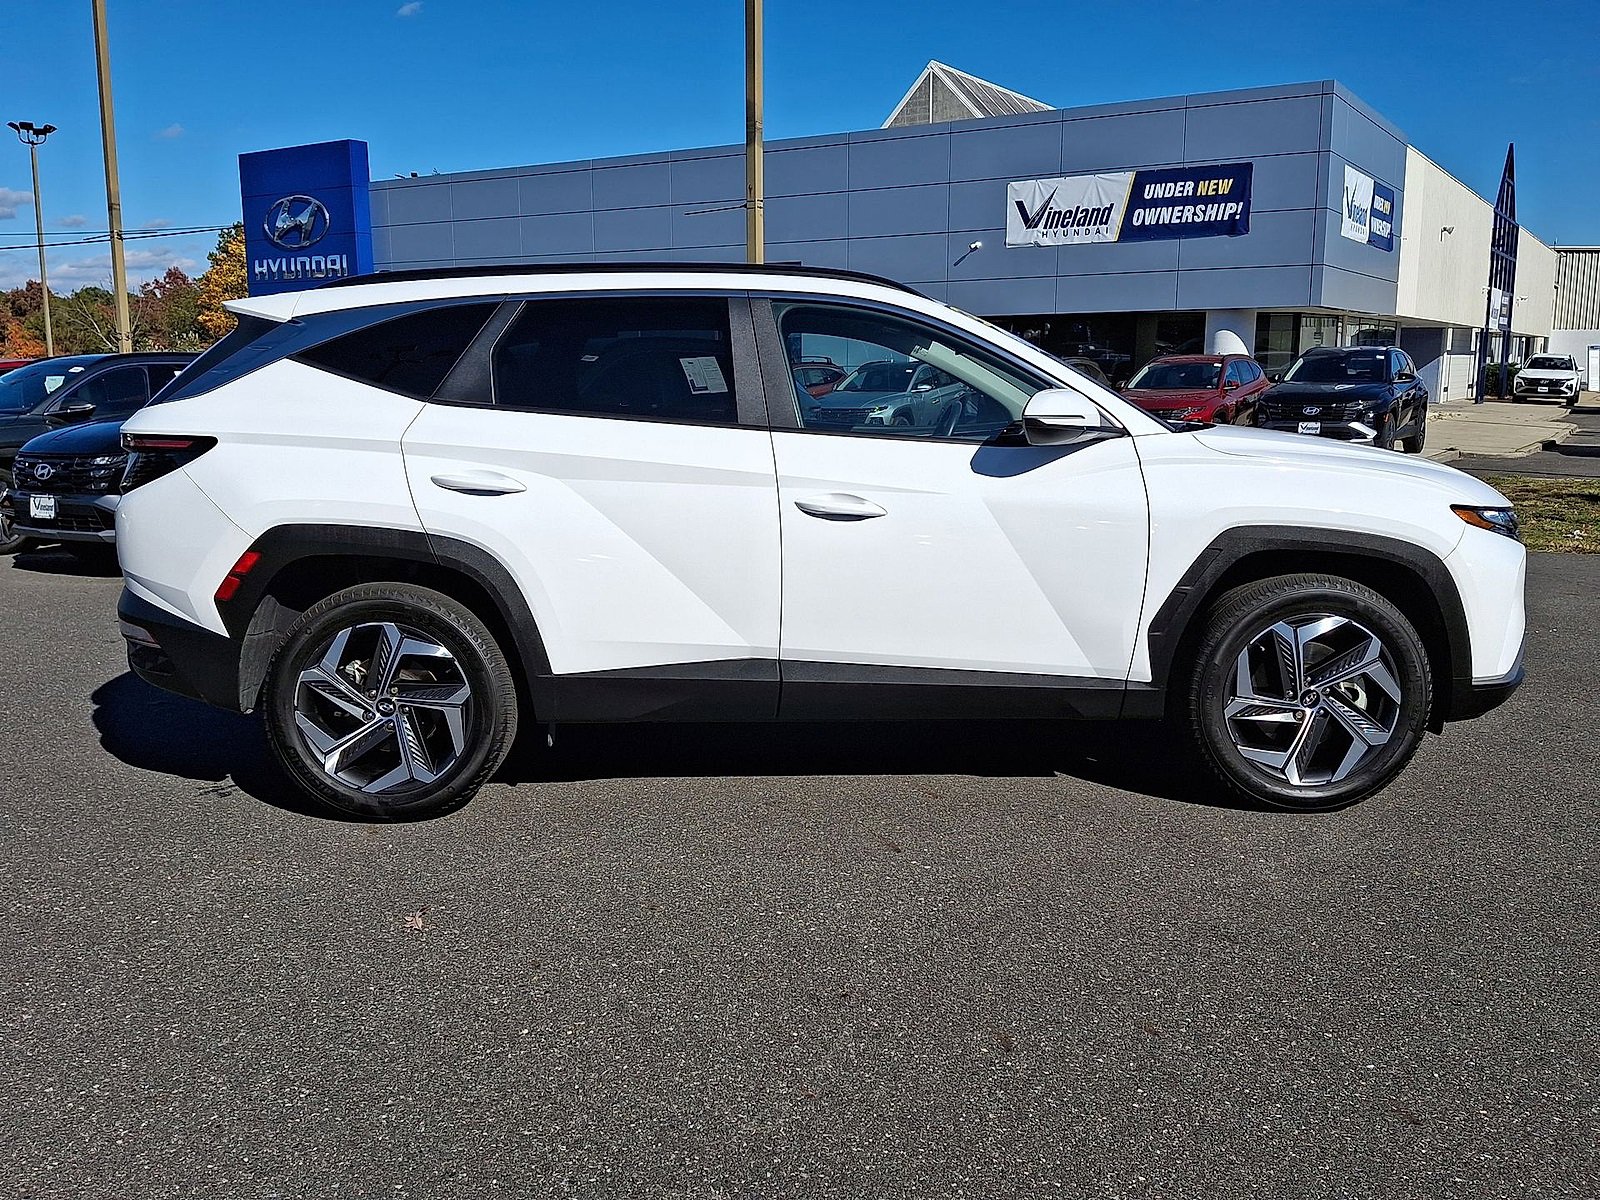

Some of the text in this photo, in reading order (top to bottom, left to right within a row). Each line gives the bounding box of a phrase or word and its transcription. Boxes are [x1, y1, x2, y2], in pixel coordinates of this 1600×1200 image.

[1143, 178, 1233, 199] UNDER NEW
[1014, 185, 1115, 230] Vineland
[1132, 202, 1244, 226] OWNERSHIP!
[1041, 227, 1109, 239] HYUNDAI
[254, 253, 348, 280] HYUNDAI
